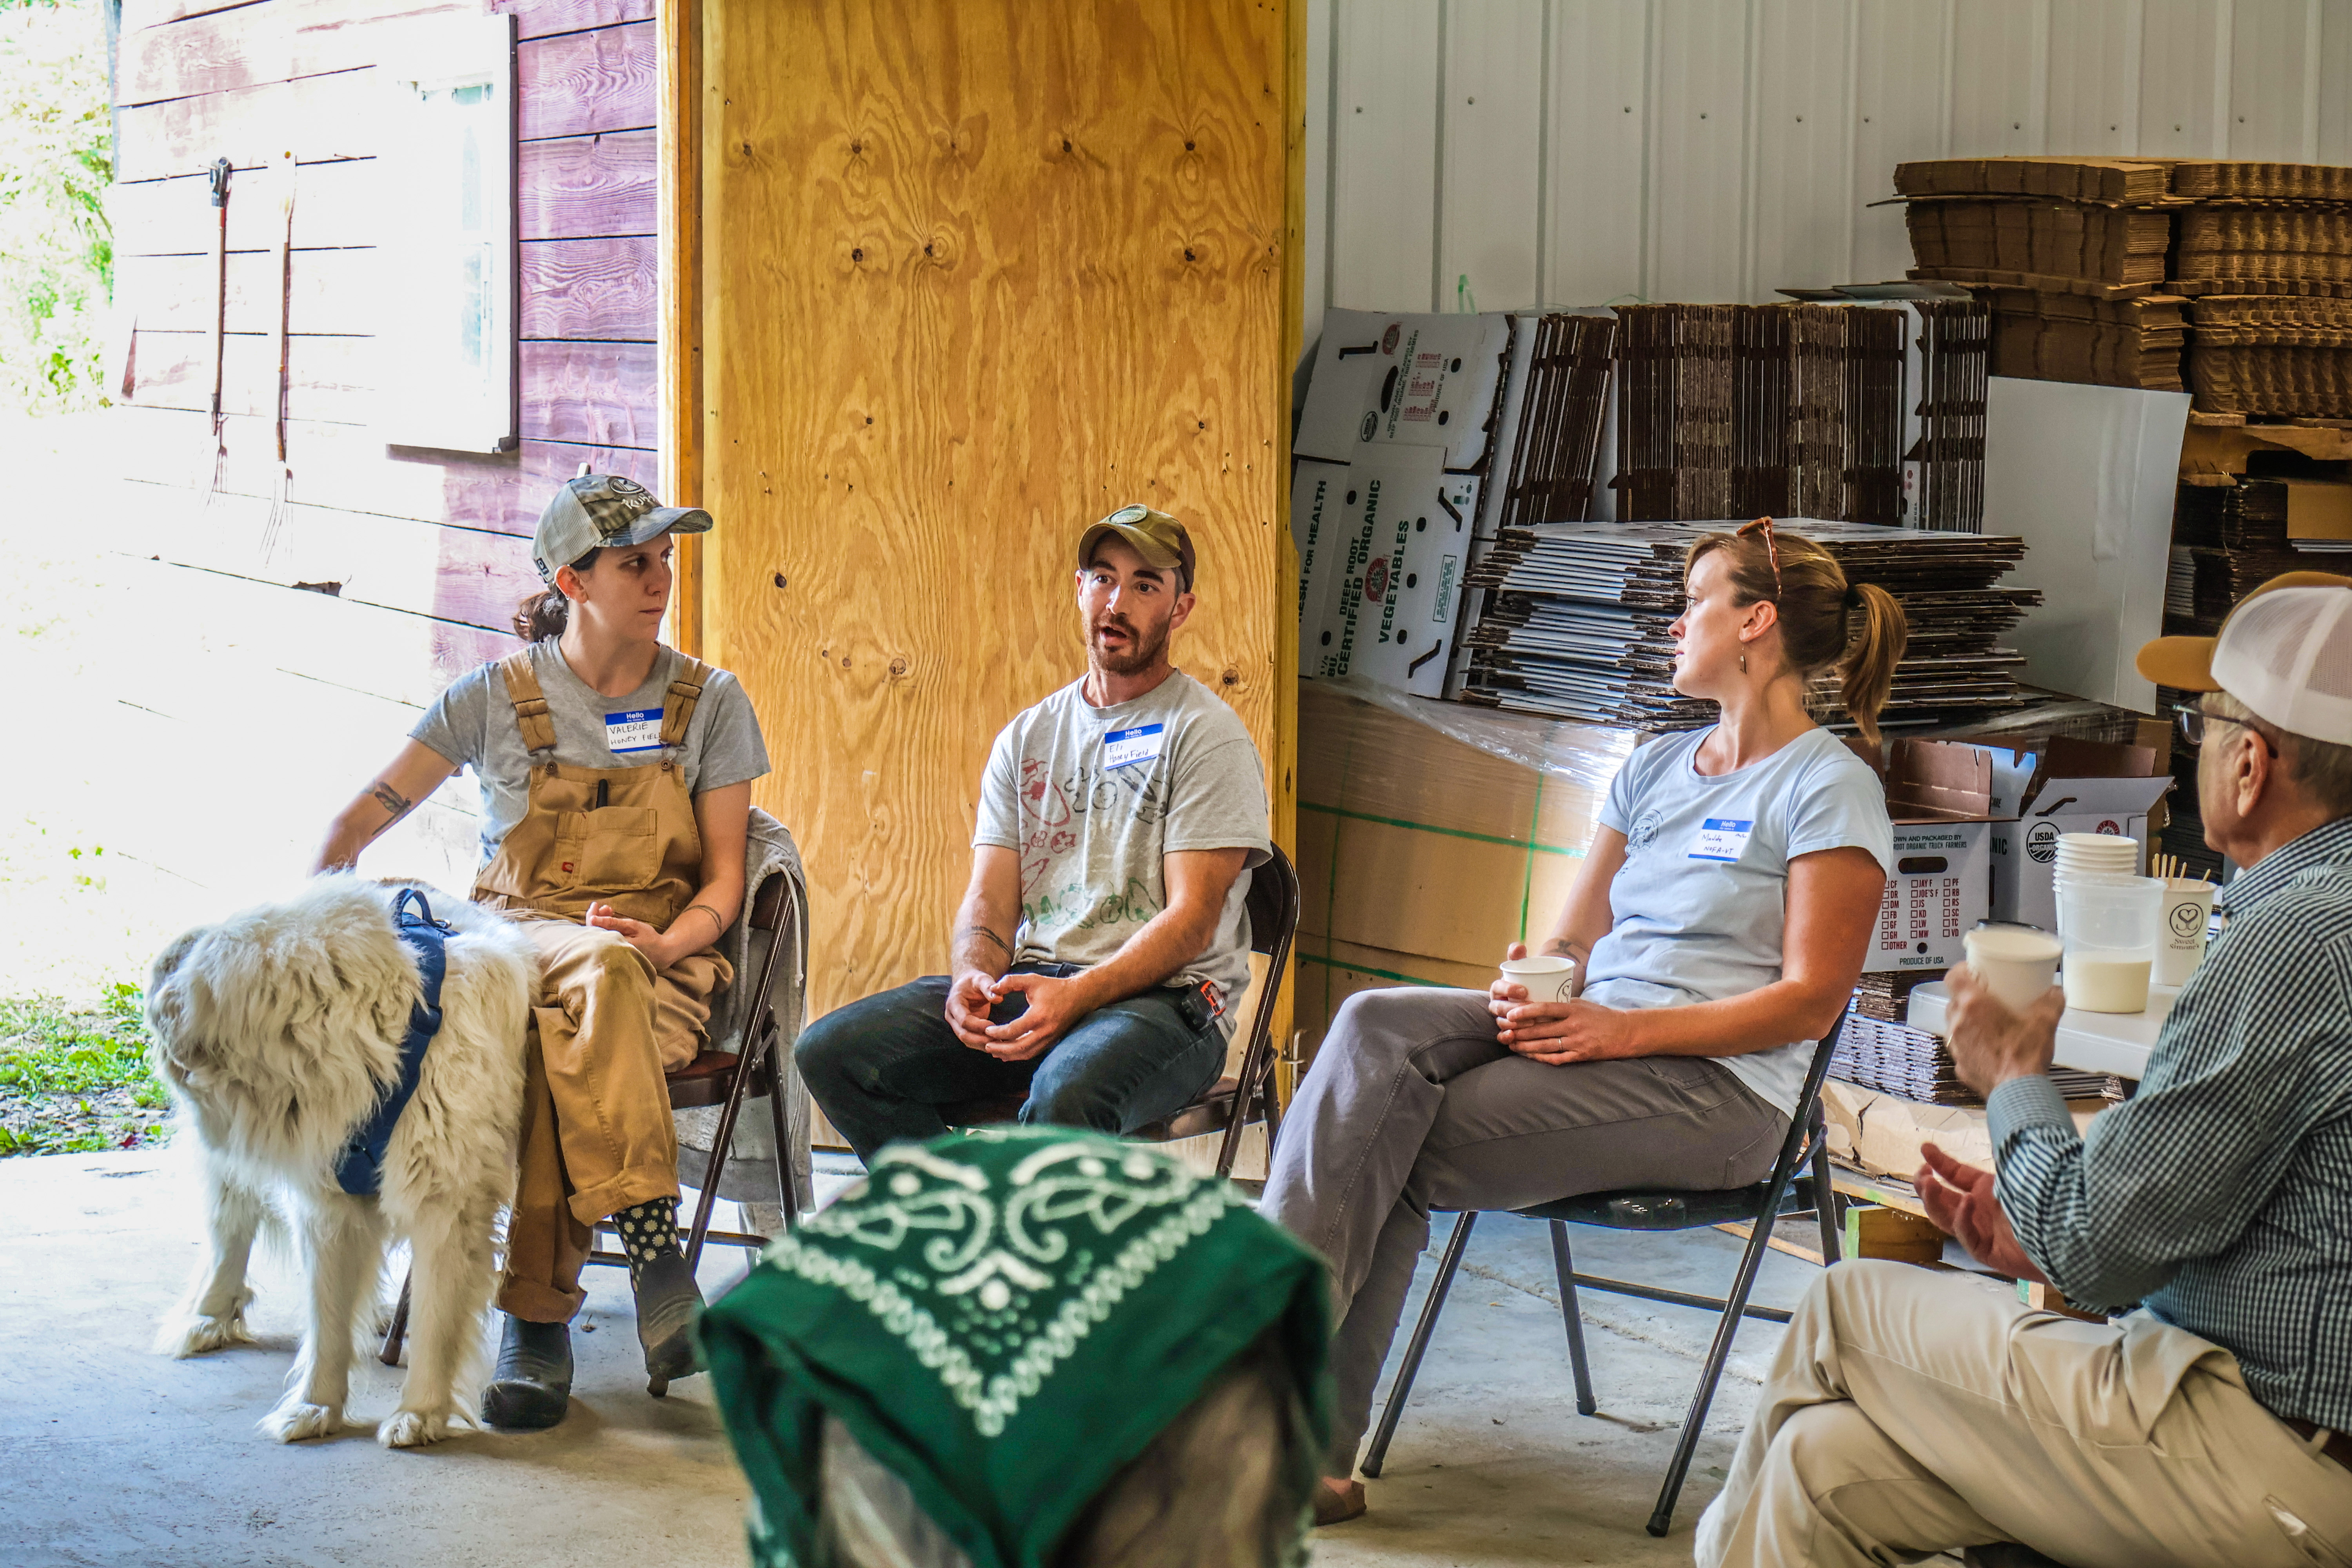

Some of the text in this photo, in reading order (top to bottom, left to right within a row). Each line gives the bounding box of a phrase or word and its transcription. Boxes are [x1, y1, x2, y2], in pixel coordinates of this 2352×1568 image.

[1299, 481, 1327, 623] ESH FOR HEALTH
[1338, 577, 1363, 675] CERTIFIED
[1357, 480, 1381, 564] ORGANIC
[1339, 537, 1359, 615] DEEP ROOT
[1379, 520, 1409, 643] VEGETABLES
[610, 722, 648, 735] VALERIE
[611, 733, 661, 745] HONEY FIEL
[1110, 742, 1124, 752] Eli
[1109, 749, 1148, 764] Honey Field
[2035, 832, 2054, 841] USDA
[1704, 846, 1734, 854] NOFA-VT
[1919, 889, 1933, 898] JOE'S
[1952, 888, 1959, 897] RB
[1919, 900, 1924, 908] JS
[1951, 918, 1958, 927] TC
[1889, 941, 1907, 949] OTHER
[1900, 957, 1924, 965] PRODUCE
